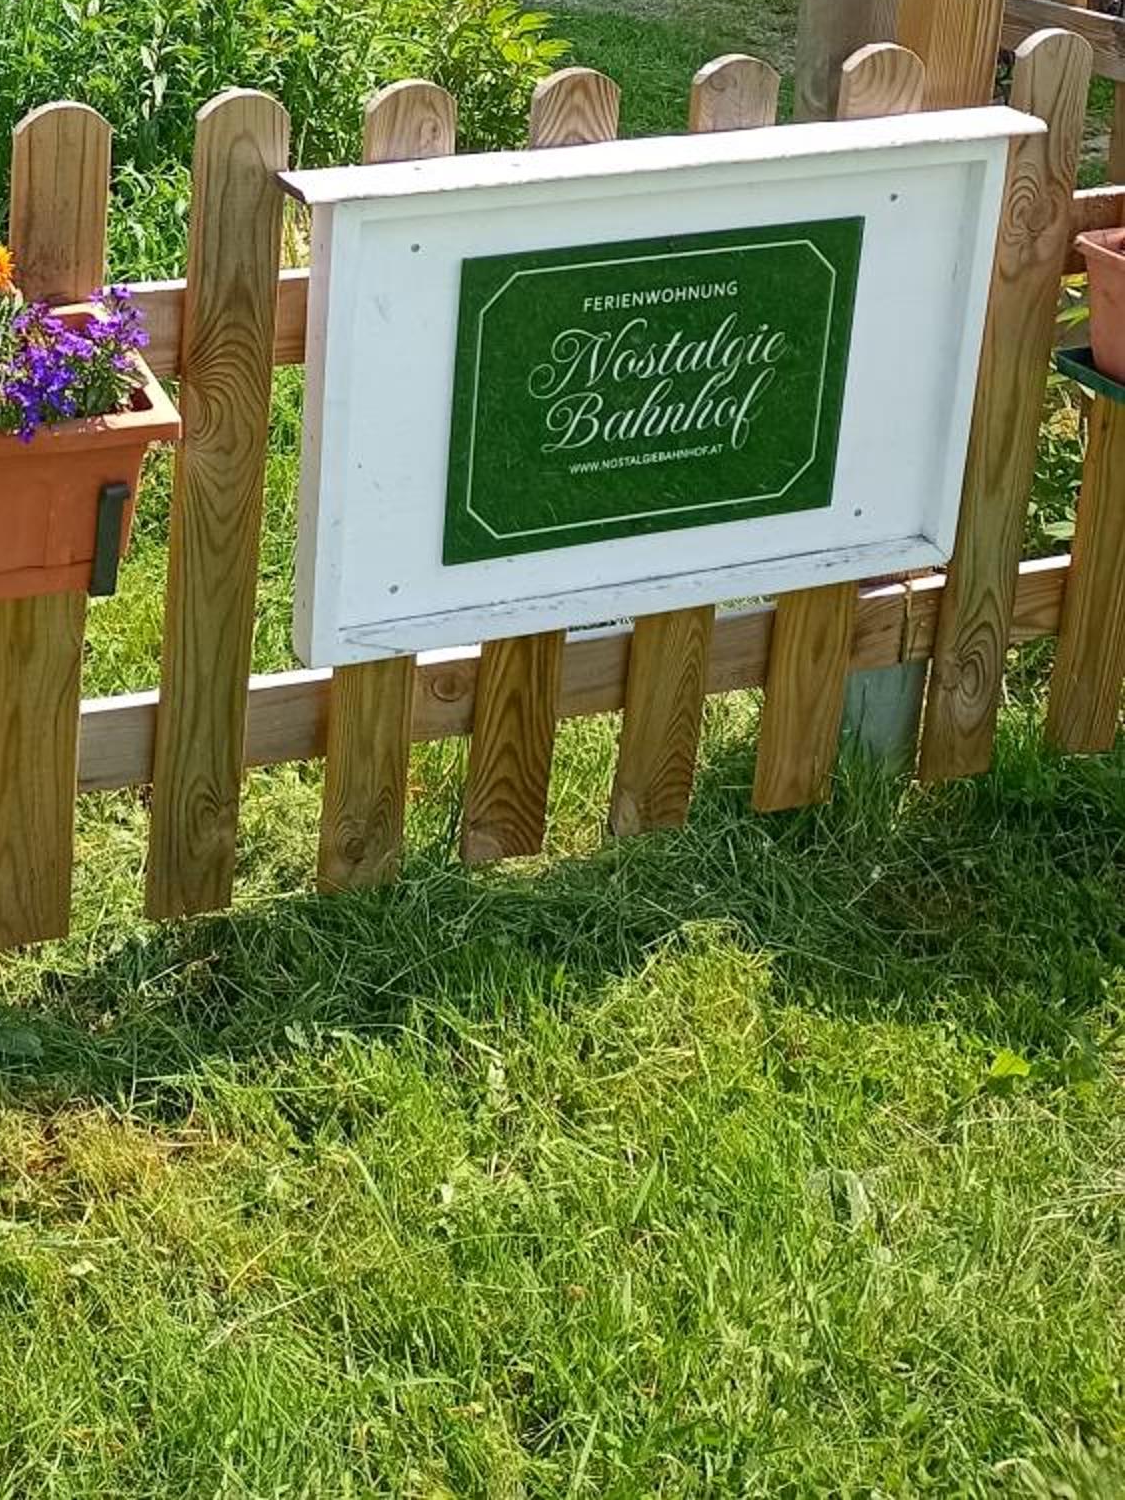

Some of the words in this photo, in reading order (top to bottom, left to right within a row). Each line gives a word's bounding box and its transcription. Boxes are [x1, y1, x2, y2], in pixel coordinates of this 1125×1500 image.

[583, 280, 739, 313] FERIENWOHNUNG
[528, 312, 788, 399] Nostalgie
[540, 368, 775, 453] Bahnhof
